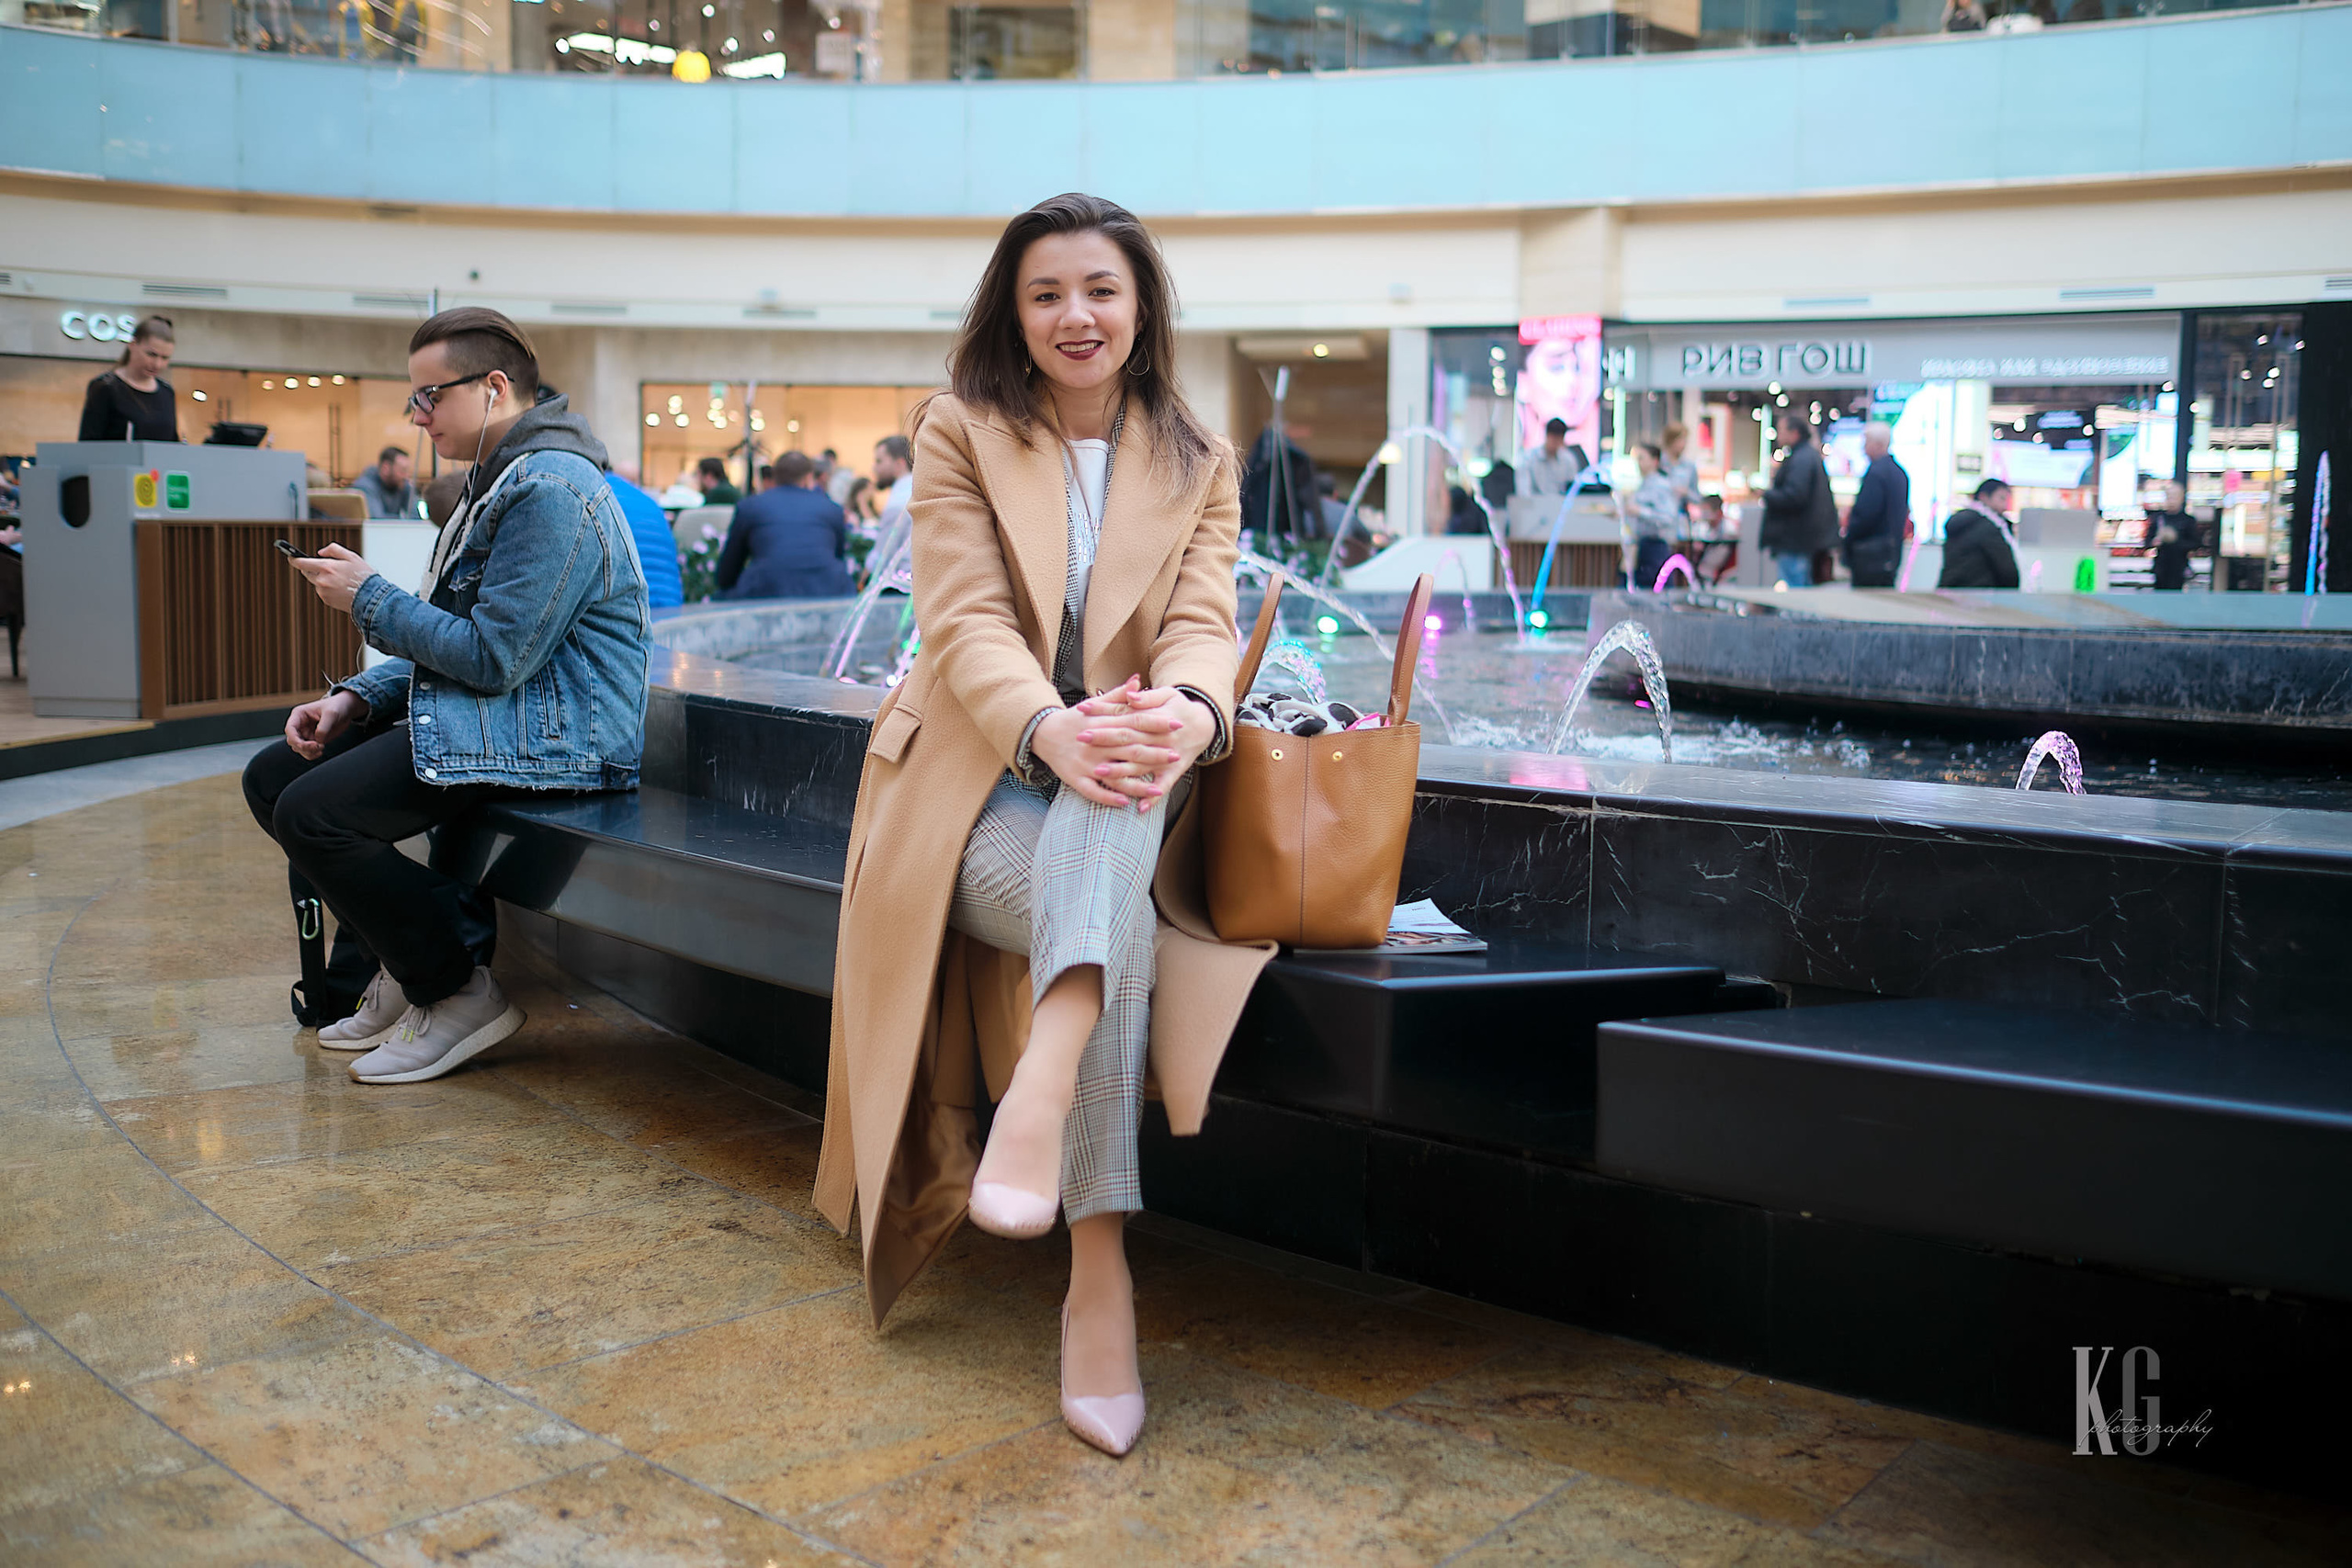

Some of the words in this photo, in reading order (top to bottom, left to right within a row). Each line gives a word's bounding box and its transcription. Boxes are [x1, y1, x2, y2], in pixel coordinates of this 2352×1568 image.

[61, 311, 137, 344] COS
[1682, 343, 1766, 378] РИВ
[1778, 340, 1871, 376] ГОШ
